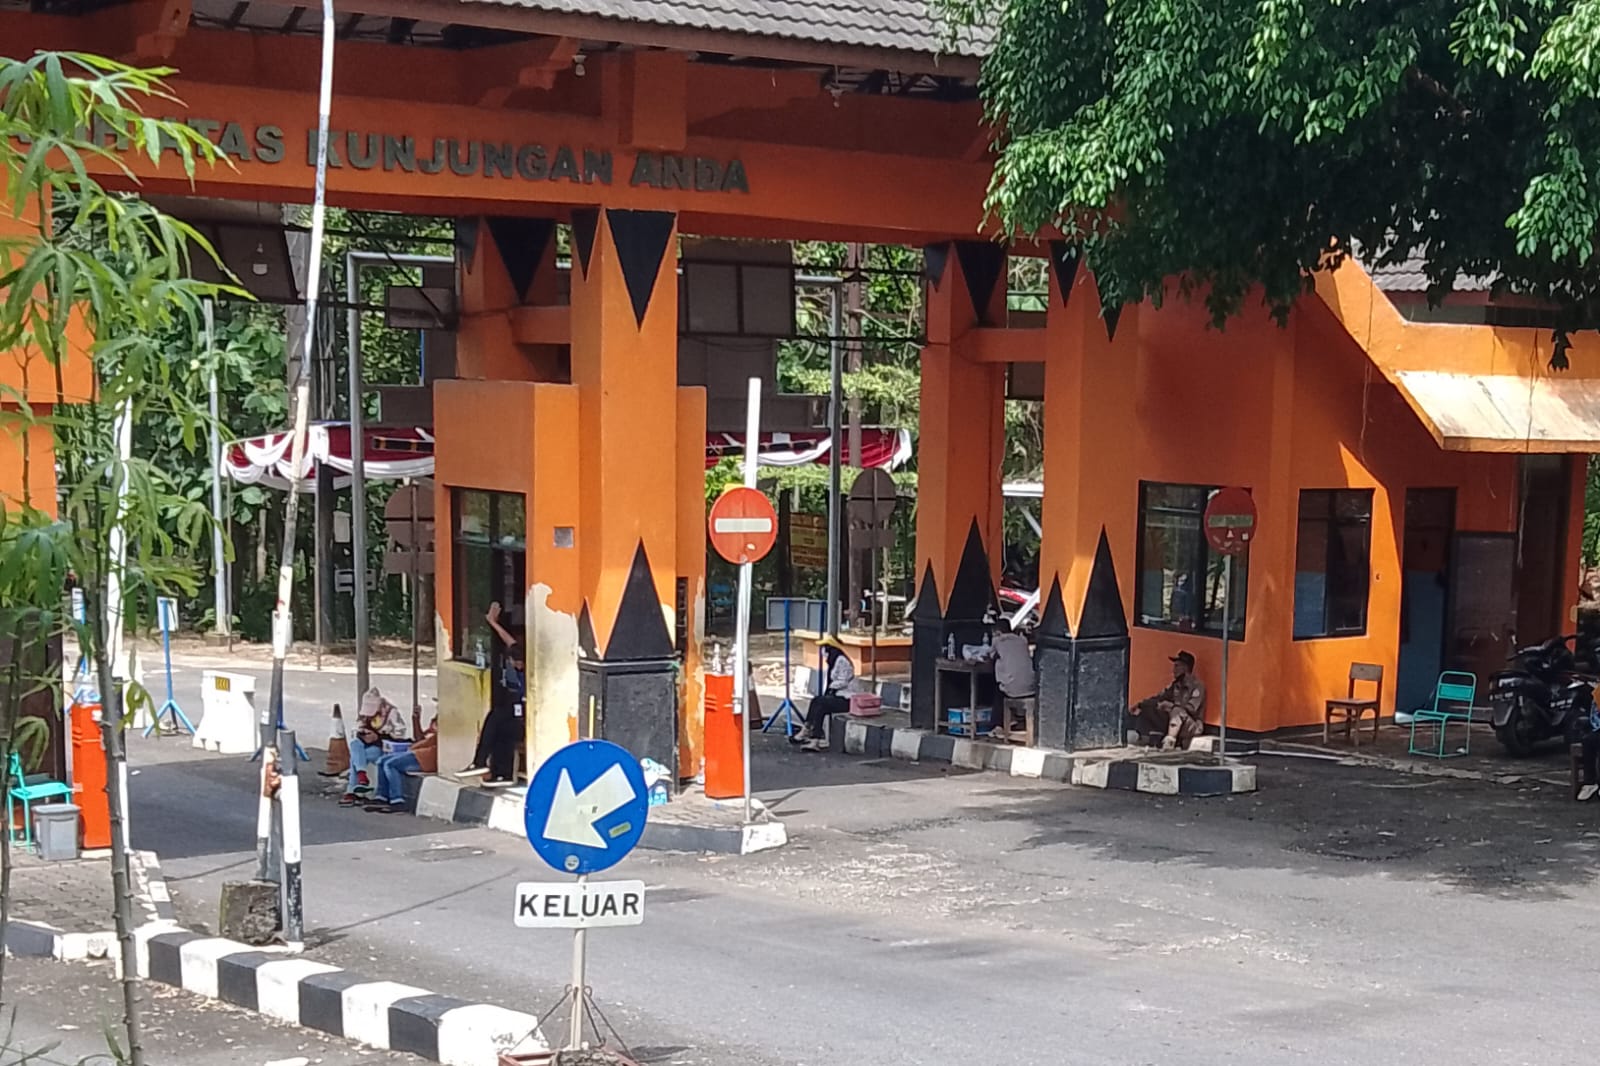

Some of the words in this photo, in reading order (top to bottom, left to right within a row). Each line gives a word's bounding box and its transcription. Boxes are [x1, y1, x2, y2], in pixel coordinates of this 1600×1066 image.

[307, 129, 613, 185] KUNJUNGAN
[631, 151, 750, 193] ANDA
[518, 892, 640, 918] KELUAR
